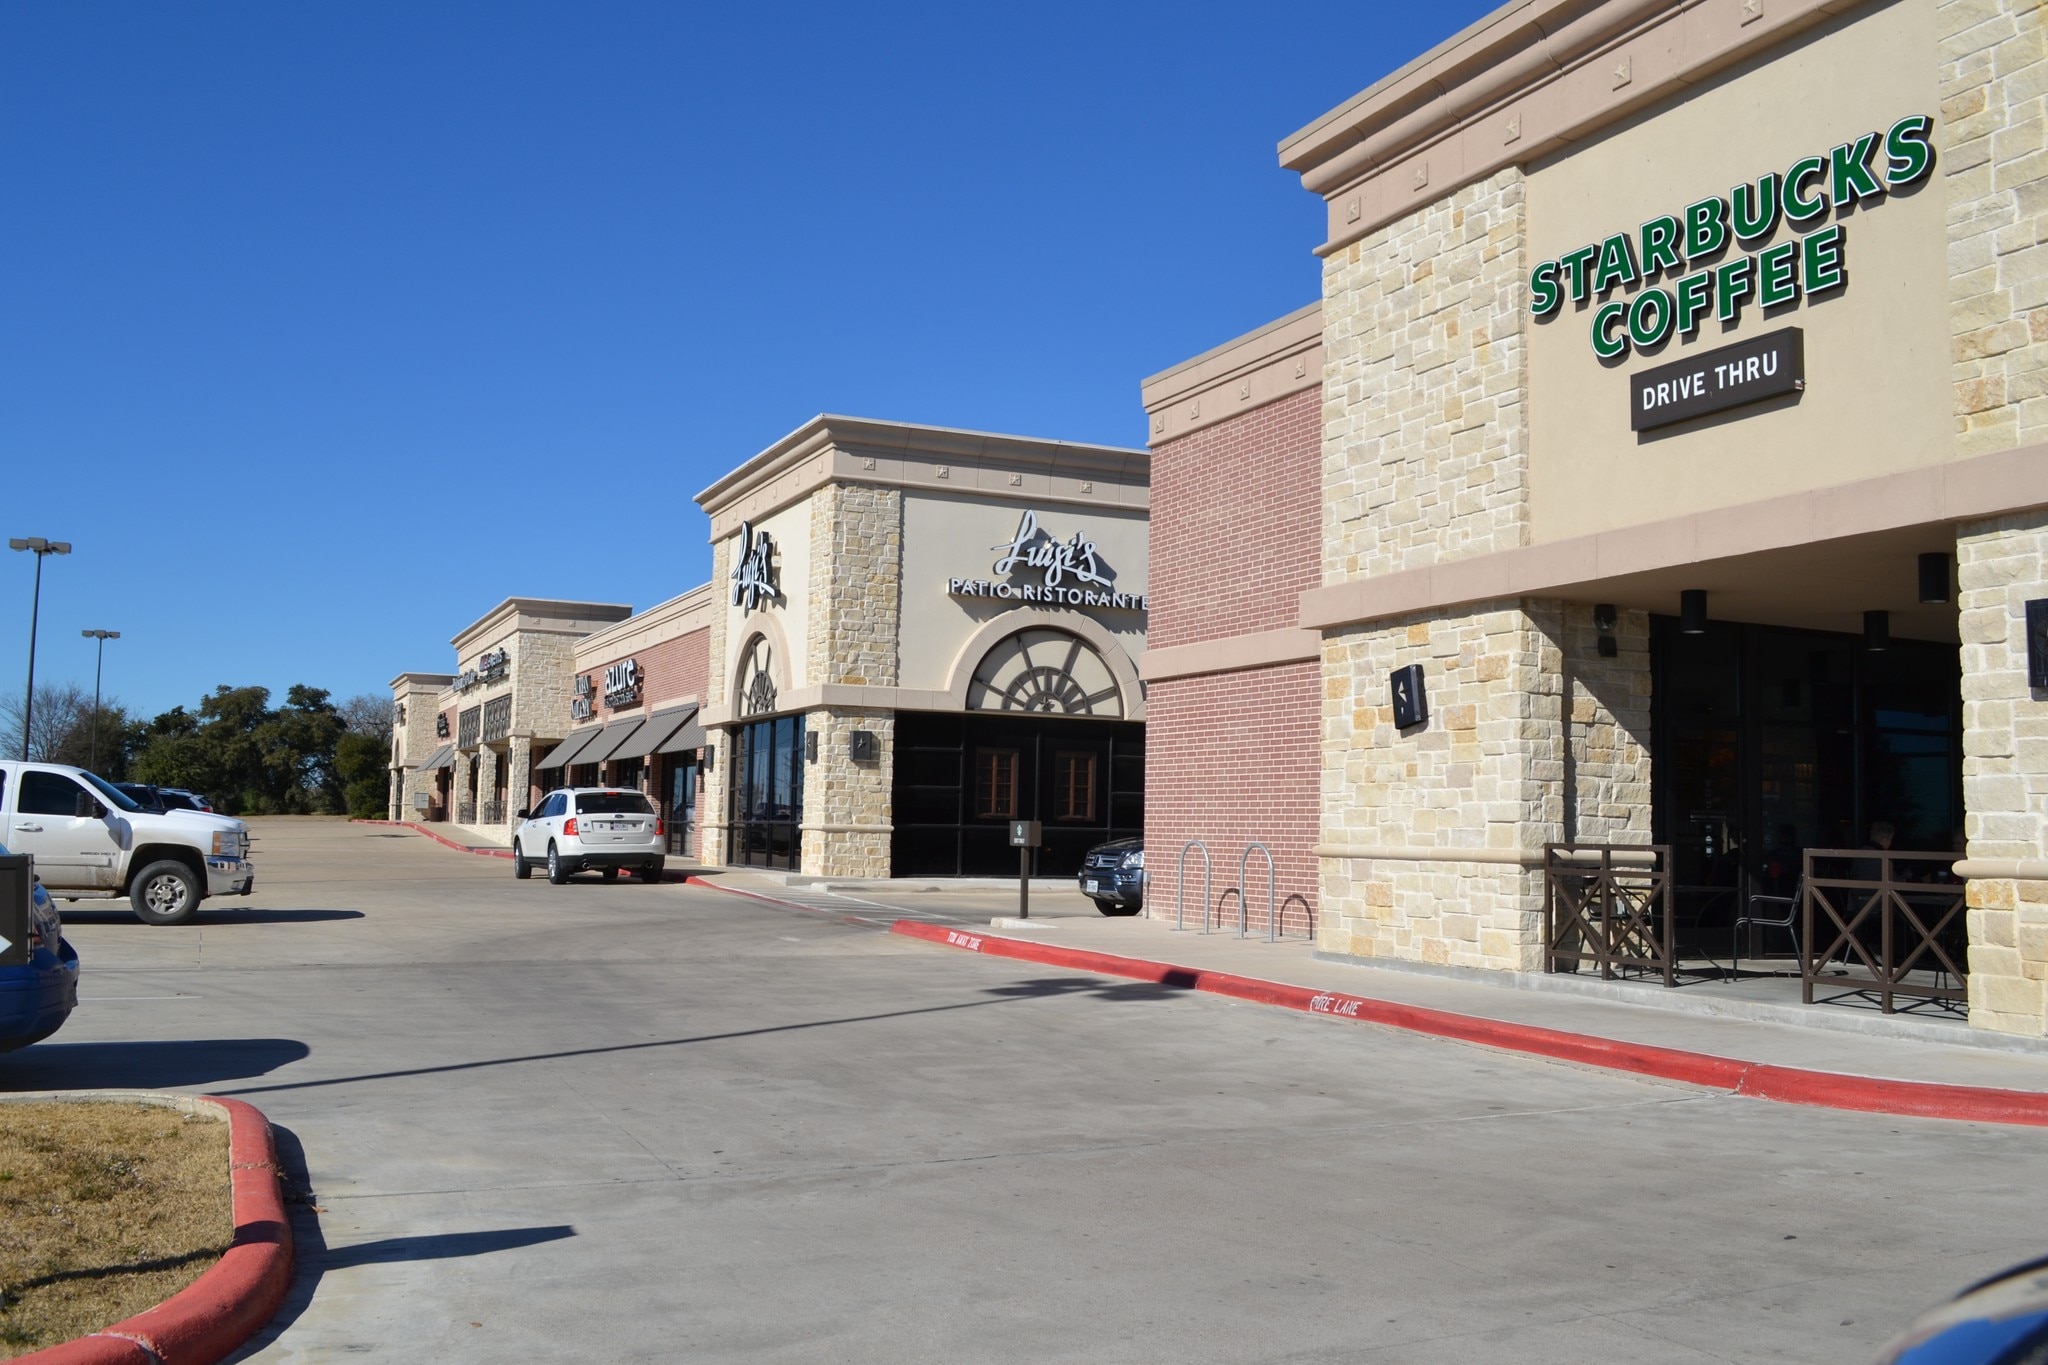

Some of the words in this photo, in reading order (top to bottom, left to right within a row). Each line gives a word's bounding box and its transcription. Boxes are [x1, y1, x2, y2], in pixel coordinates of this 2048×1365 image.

[1529, 114, 1933, 316] STARBUCKS
[1589, 224, 1843, 358] COFFEE
[1642, 371, 1706, 411] DRIVE
[1714, 350, 1778, 391] THRU
[990, 509, 1112, 587] Luigi's
[950, 577, 1013, 599] PATIO
[1023, 583, 1149, 611] RISTORANTE
[604, 659, 635, 695] azure
[1309, 995, 1335, 1012] FIRE
[1333, 999, 1363, 1016] LANE
